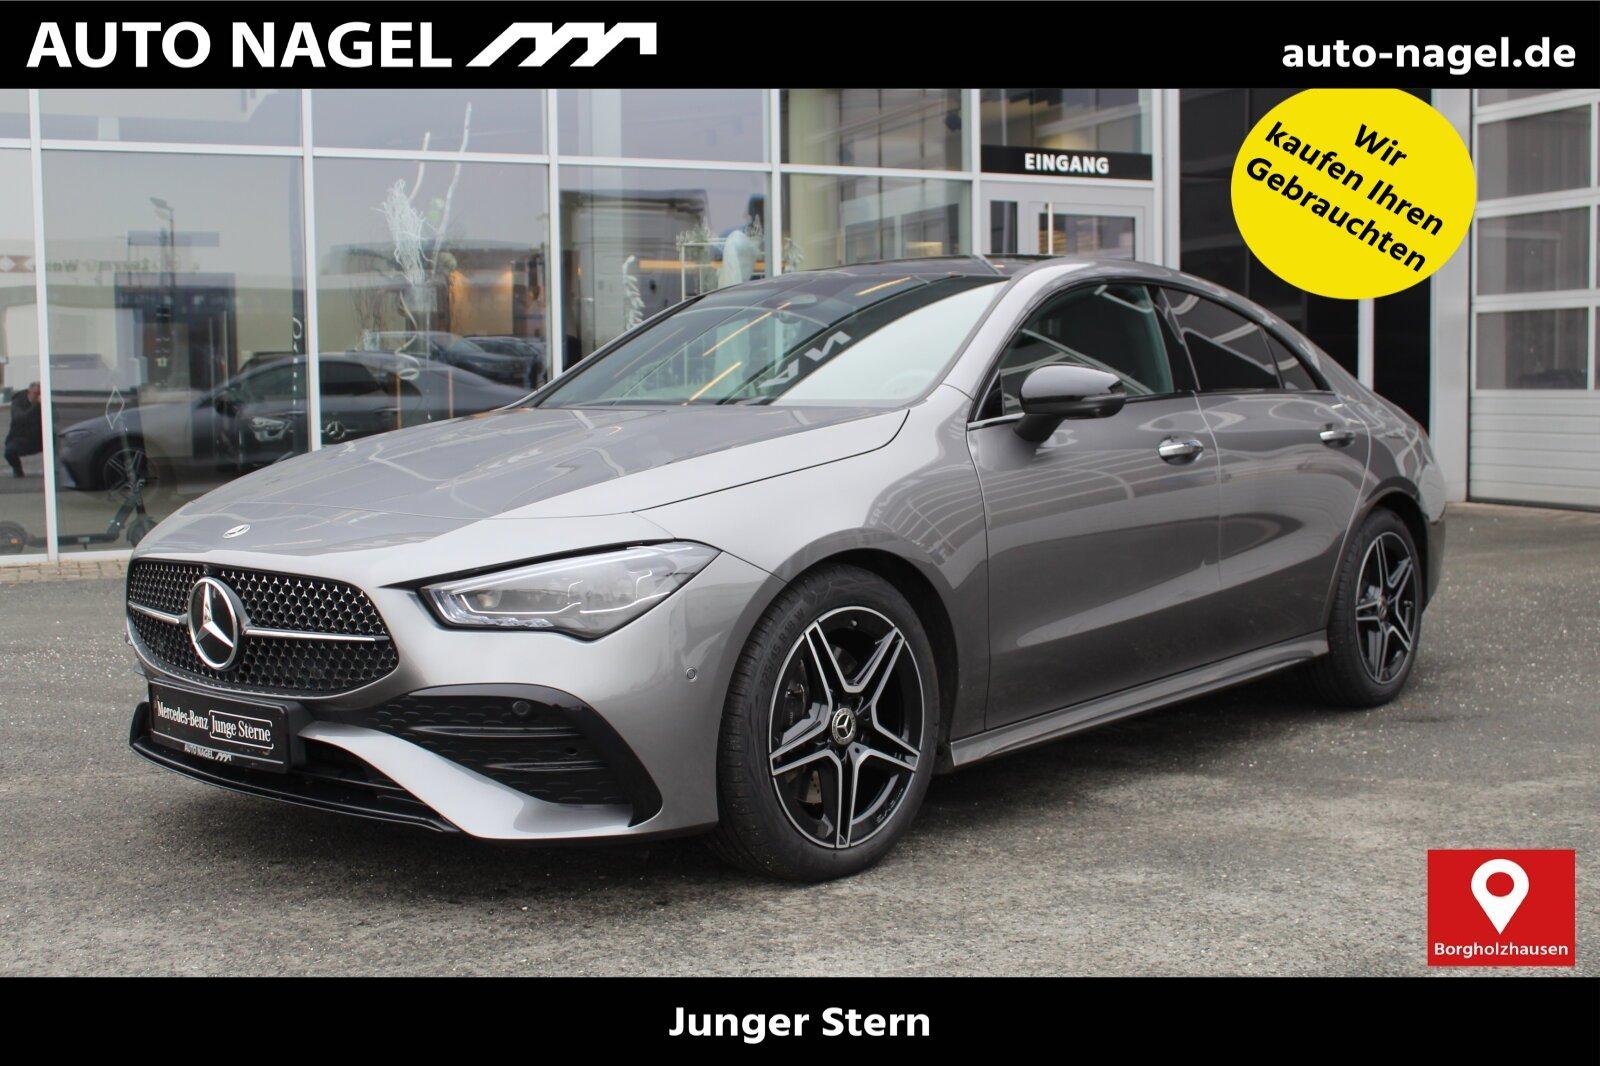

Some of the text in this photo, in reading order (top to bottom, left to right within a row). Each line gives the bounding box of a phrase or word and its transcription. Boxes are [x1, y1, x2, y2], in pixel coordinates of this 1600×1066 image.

[1024, 153, 1110, 174] EINGANG
[157, 700, 271, 742] Mercedes-Benz Junge Sterne
